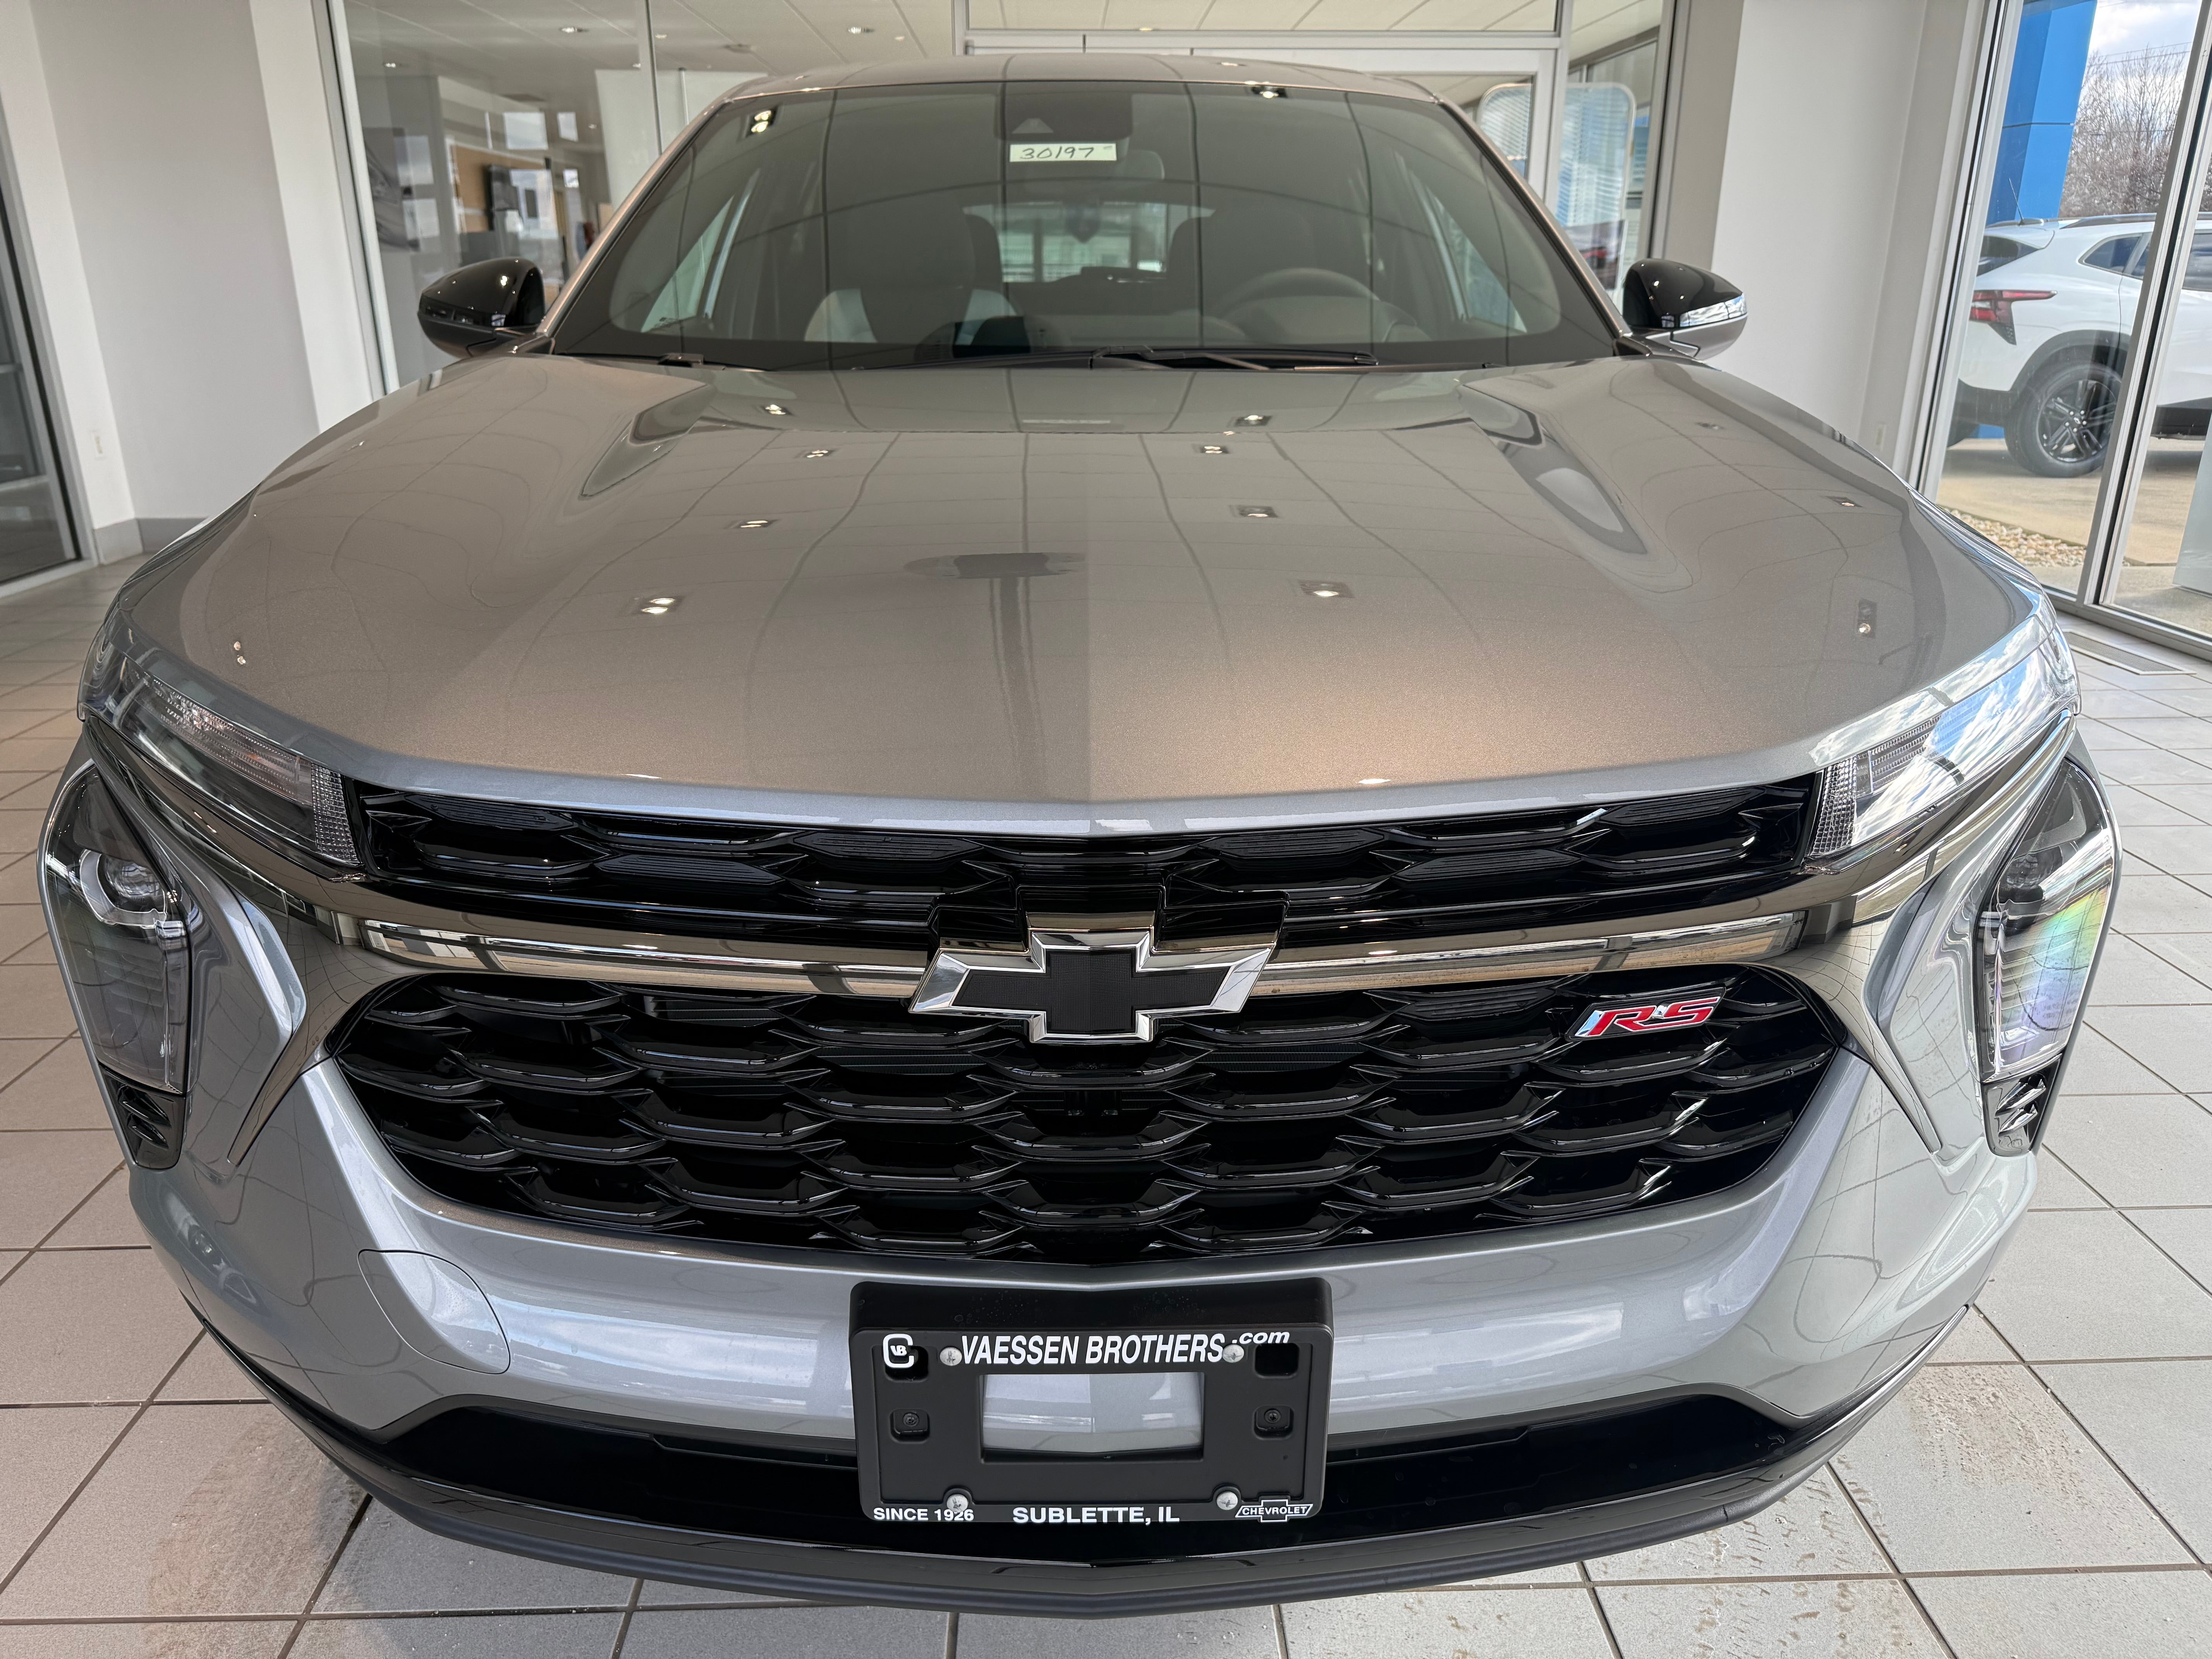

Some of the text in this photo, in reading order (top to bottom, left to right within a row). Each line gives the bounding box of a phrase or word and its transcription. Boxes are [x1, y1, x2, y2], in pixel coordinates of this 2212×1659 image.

[1020, 146, 1094, 160] 30197
[1575, 996, 1721, 1037] RS
[962, 1335, 1079, 1365] VAESSEN
[873, 1507, 974, 1521] SINCE 1926
[1013, 1506, 1180, 1526] SUBLETTE, IL
[1242, 1506, 1307, 1515] CHEVROLET
